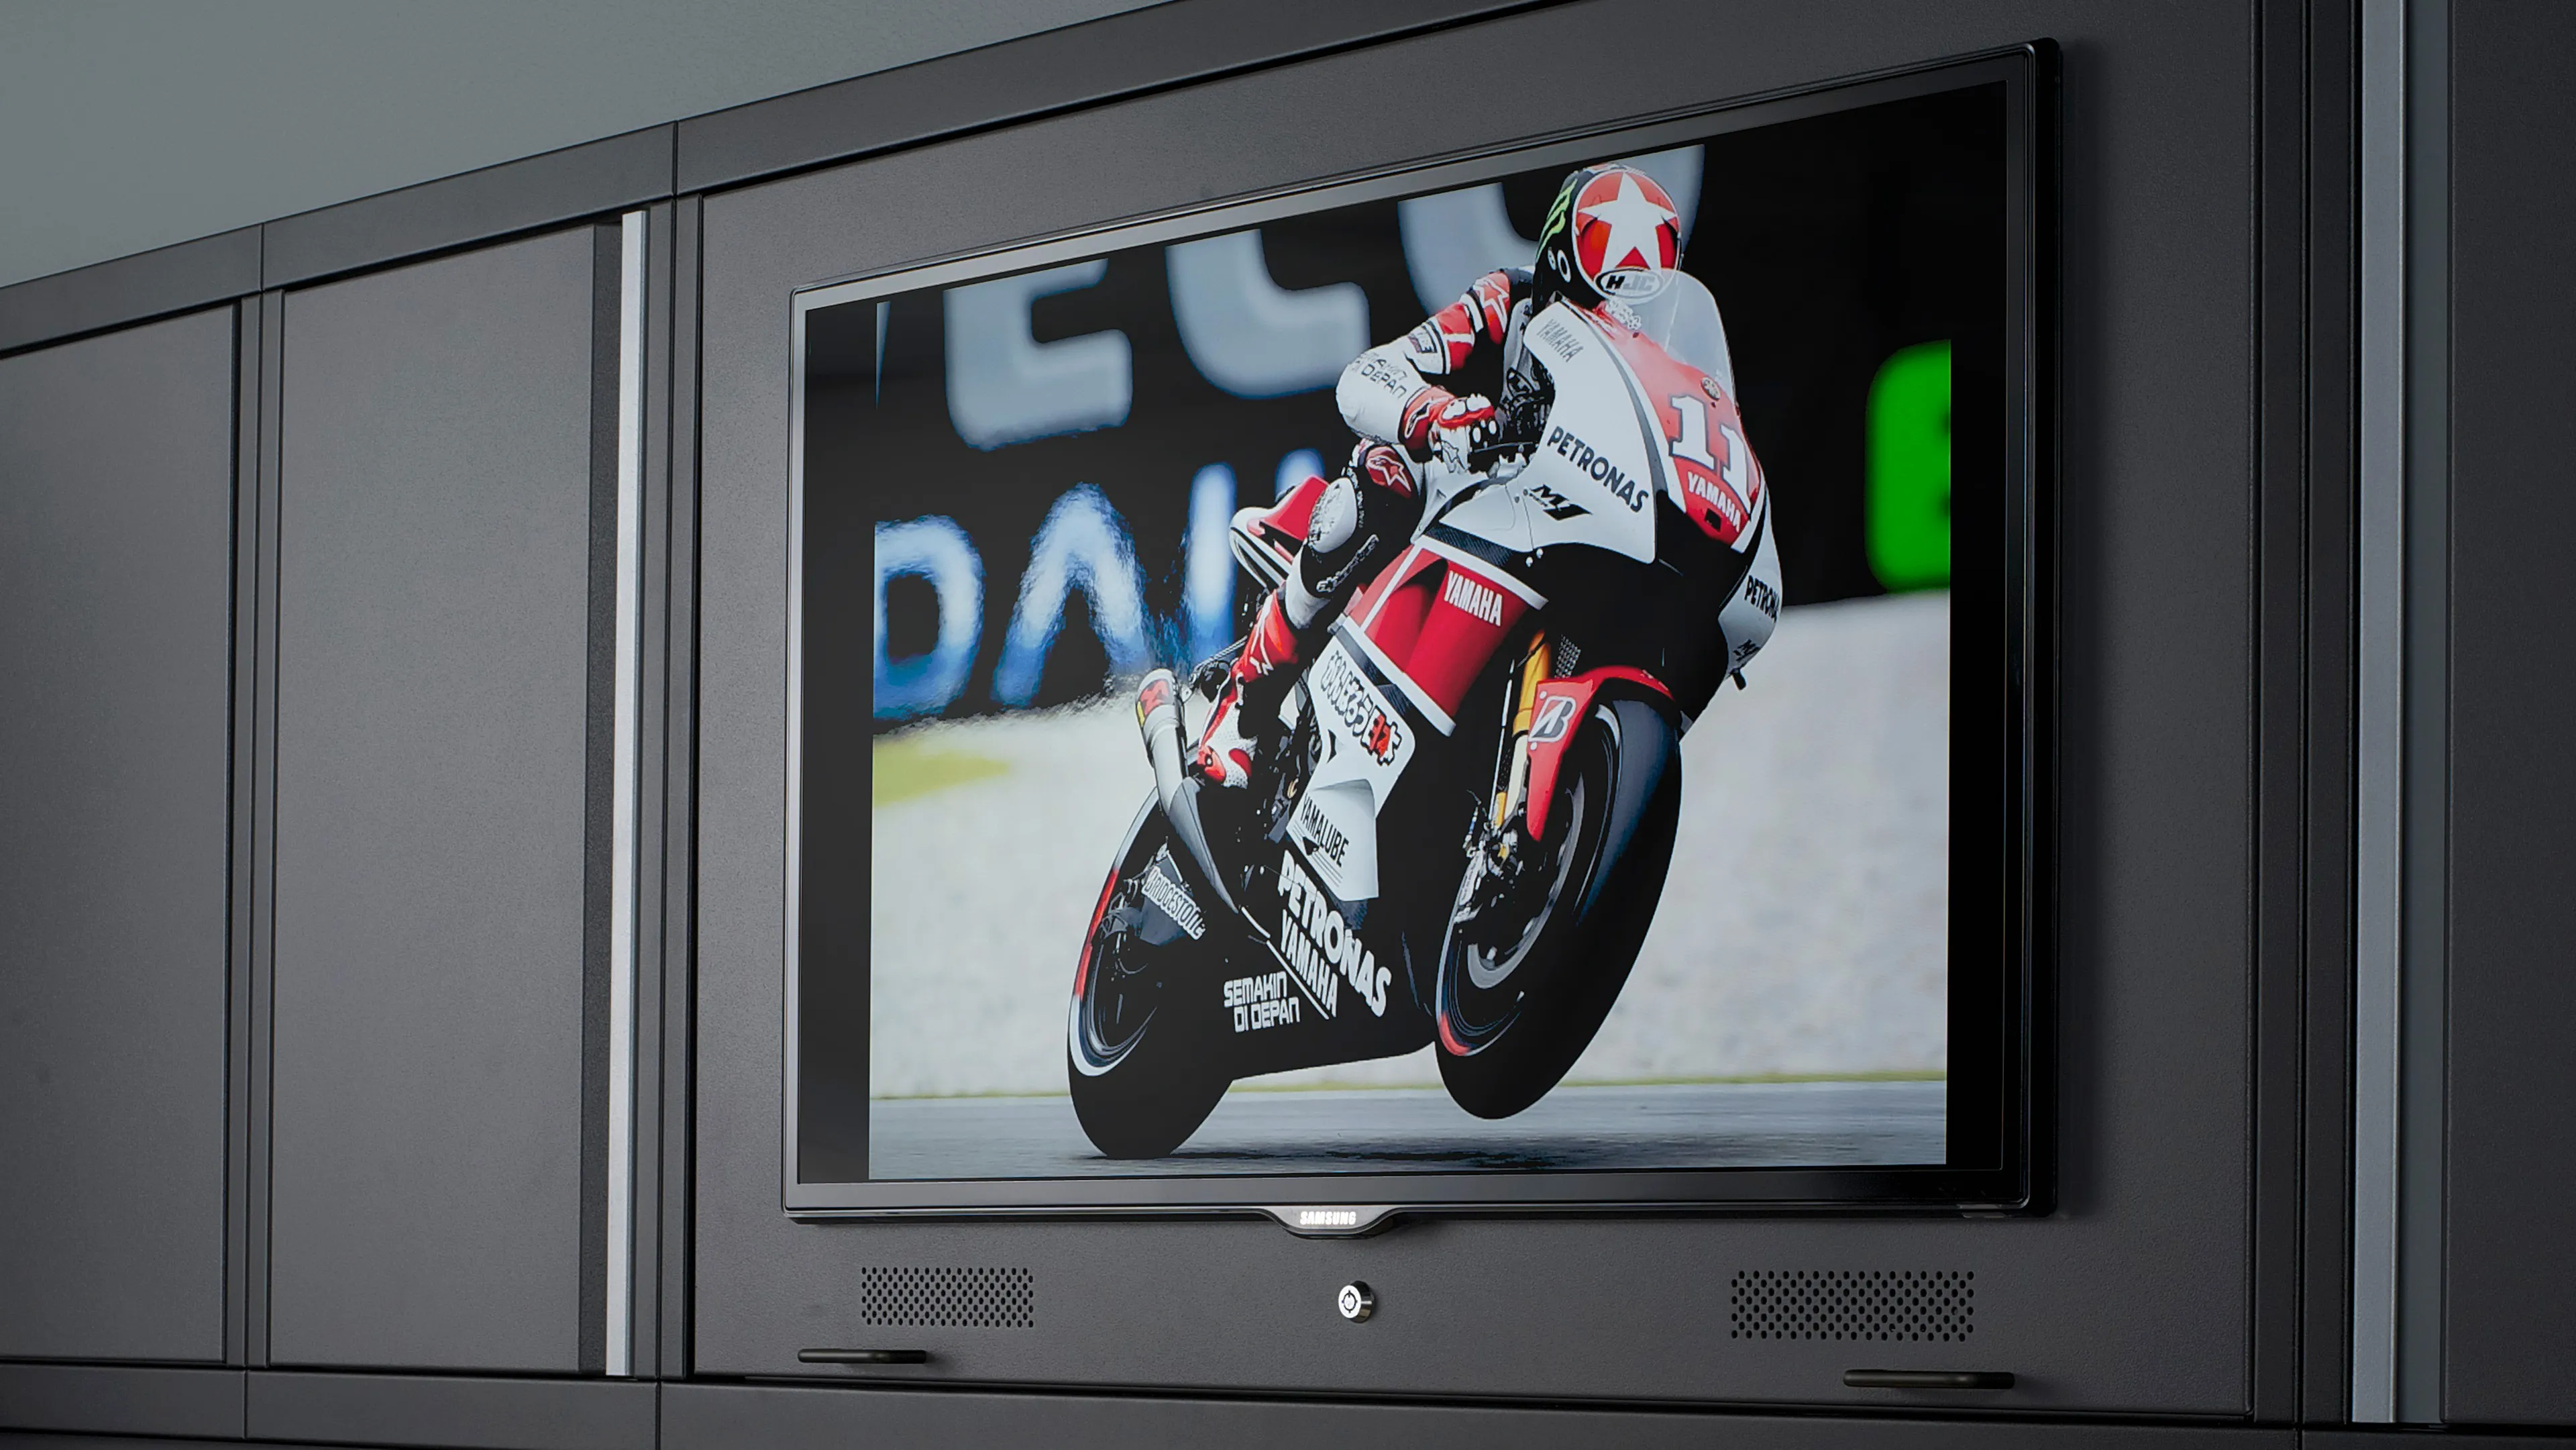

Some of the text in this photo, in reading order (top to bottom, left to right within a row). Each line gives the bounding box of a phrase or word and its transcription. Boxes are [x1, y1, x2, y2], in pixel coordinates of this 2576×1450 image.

[1605, 275, 1656, 293] HJC
[1536, 319, 1584, 362] YAMAHA
[1547, 425, 1650, 513] PETRONAS
[1670, 394, 1752, 515] 11
[1687, 471, 1741, 533] YAMAHA
[873, 448, 1326, 722] DAI
[1444, 570, 1503, 627] YAMAHA
[1300, 792, 1350, 868] YAMALUBE
[1277, 849, 1392, 1017] PETRONAS
[1281, 909, 1338, 1017] YAMAHA
[1224, 970, 1288, 1008] SEMAKIN
[1234, 996, 1301, 1033] DI DEPAN
[1299, 1211, 1356, 1225] SAMSUNG
